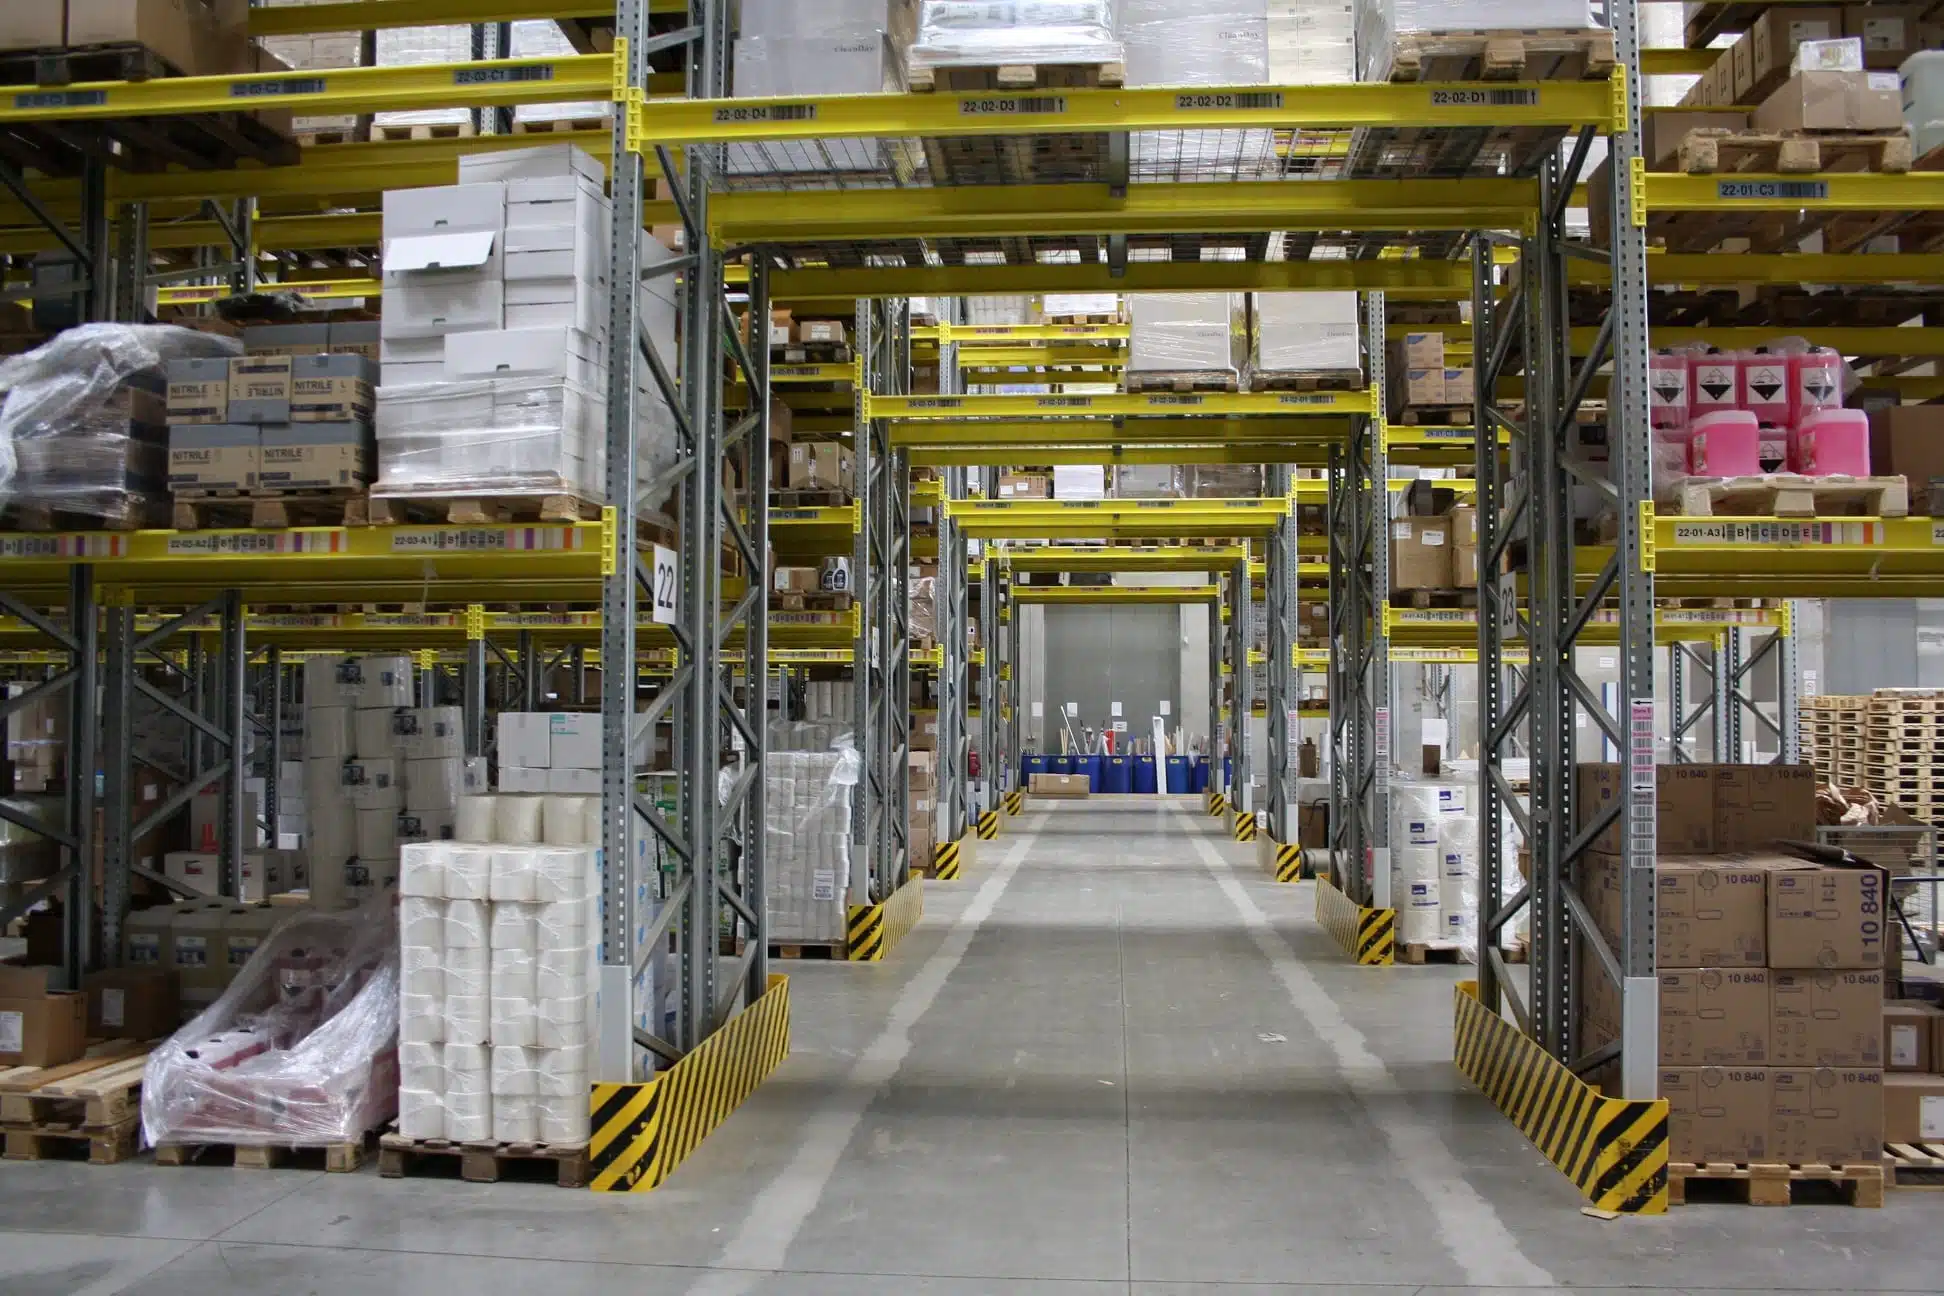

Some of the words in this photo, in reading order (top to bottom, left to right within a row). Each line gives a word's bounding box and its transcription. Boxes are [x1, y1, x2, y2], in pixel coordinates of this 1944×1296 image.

[1179, 96, 1232, 107] 22-02-D2
[1433, 91, 1485, 103] 22-02-D1
[963, 100, 1015, 112] 22-02-D3
[716, 108, 766, 120] 22-02-D4
[1721, 184, 1774, 196] 22-01-C3
[170, 385, 208, 394] NITRILE
[295, 380, 333, 390] NITRILE
[247, 387, 284, 397] NITRILE
[172, 451, 211, 460] NITRILE
[265, 448, 302, 458] NITRILE
[1678, 528, 1720, 537] 22-01-A3
[1737, 528, 1744, 537] B
[1761, 528, 1769, 537] C
[1782, 528, 1790, 537] D
[1803, 528, 1810, 537] E
[658, 562, 674, 610] 22
[1502, 586, 1514, 627] 23
[1676, 770, 1688, 779] 10
[1690, 770, 1708, 779] 840
[1725, 874, 1737, 884] 10
[1740, 874, 1760, 884] 840
[1861, 874, 1879, 915] 840
[1861, 922, 1879, 946] 10
[1728, 974, 1741, 984] 10
[1744, 974, 1764, 984] 840
[1843, 975, 1856, 984] 10
[1858, 975, 1879, 984] 840
[1728, 1071, 1741, 1082] 10
[1744, 1071, 1765, 1082] 840
[1842, 1073, 1856, 1083] 10
[1858, 1073, 1879, 1083] 840
